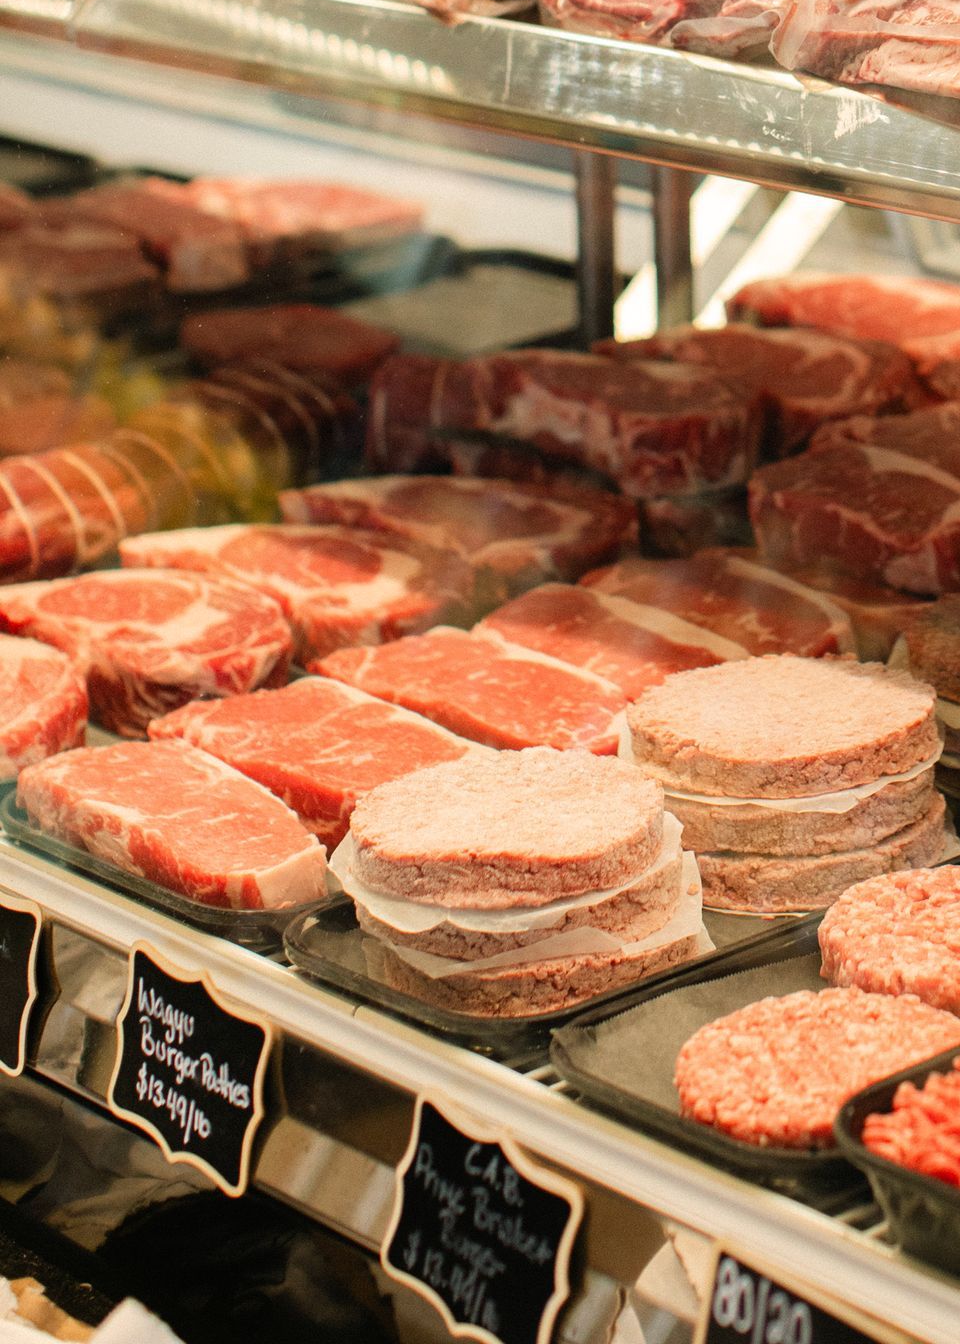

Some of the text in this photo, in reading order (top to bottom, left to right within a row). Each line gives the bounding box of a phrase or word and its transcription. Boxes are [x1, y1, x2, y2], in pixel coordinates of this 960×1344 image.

[138, 977, 195, 1044] Wagyu
[136, 1062, 212, 1144] $13.49/lb
[139, 1016, 250, 1109] Burger Patties
[713, 1257, 812, 1344] 80/20
